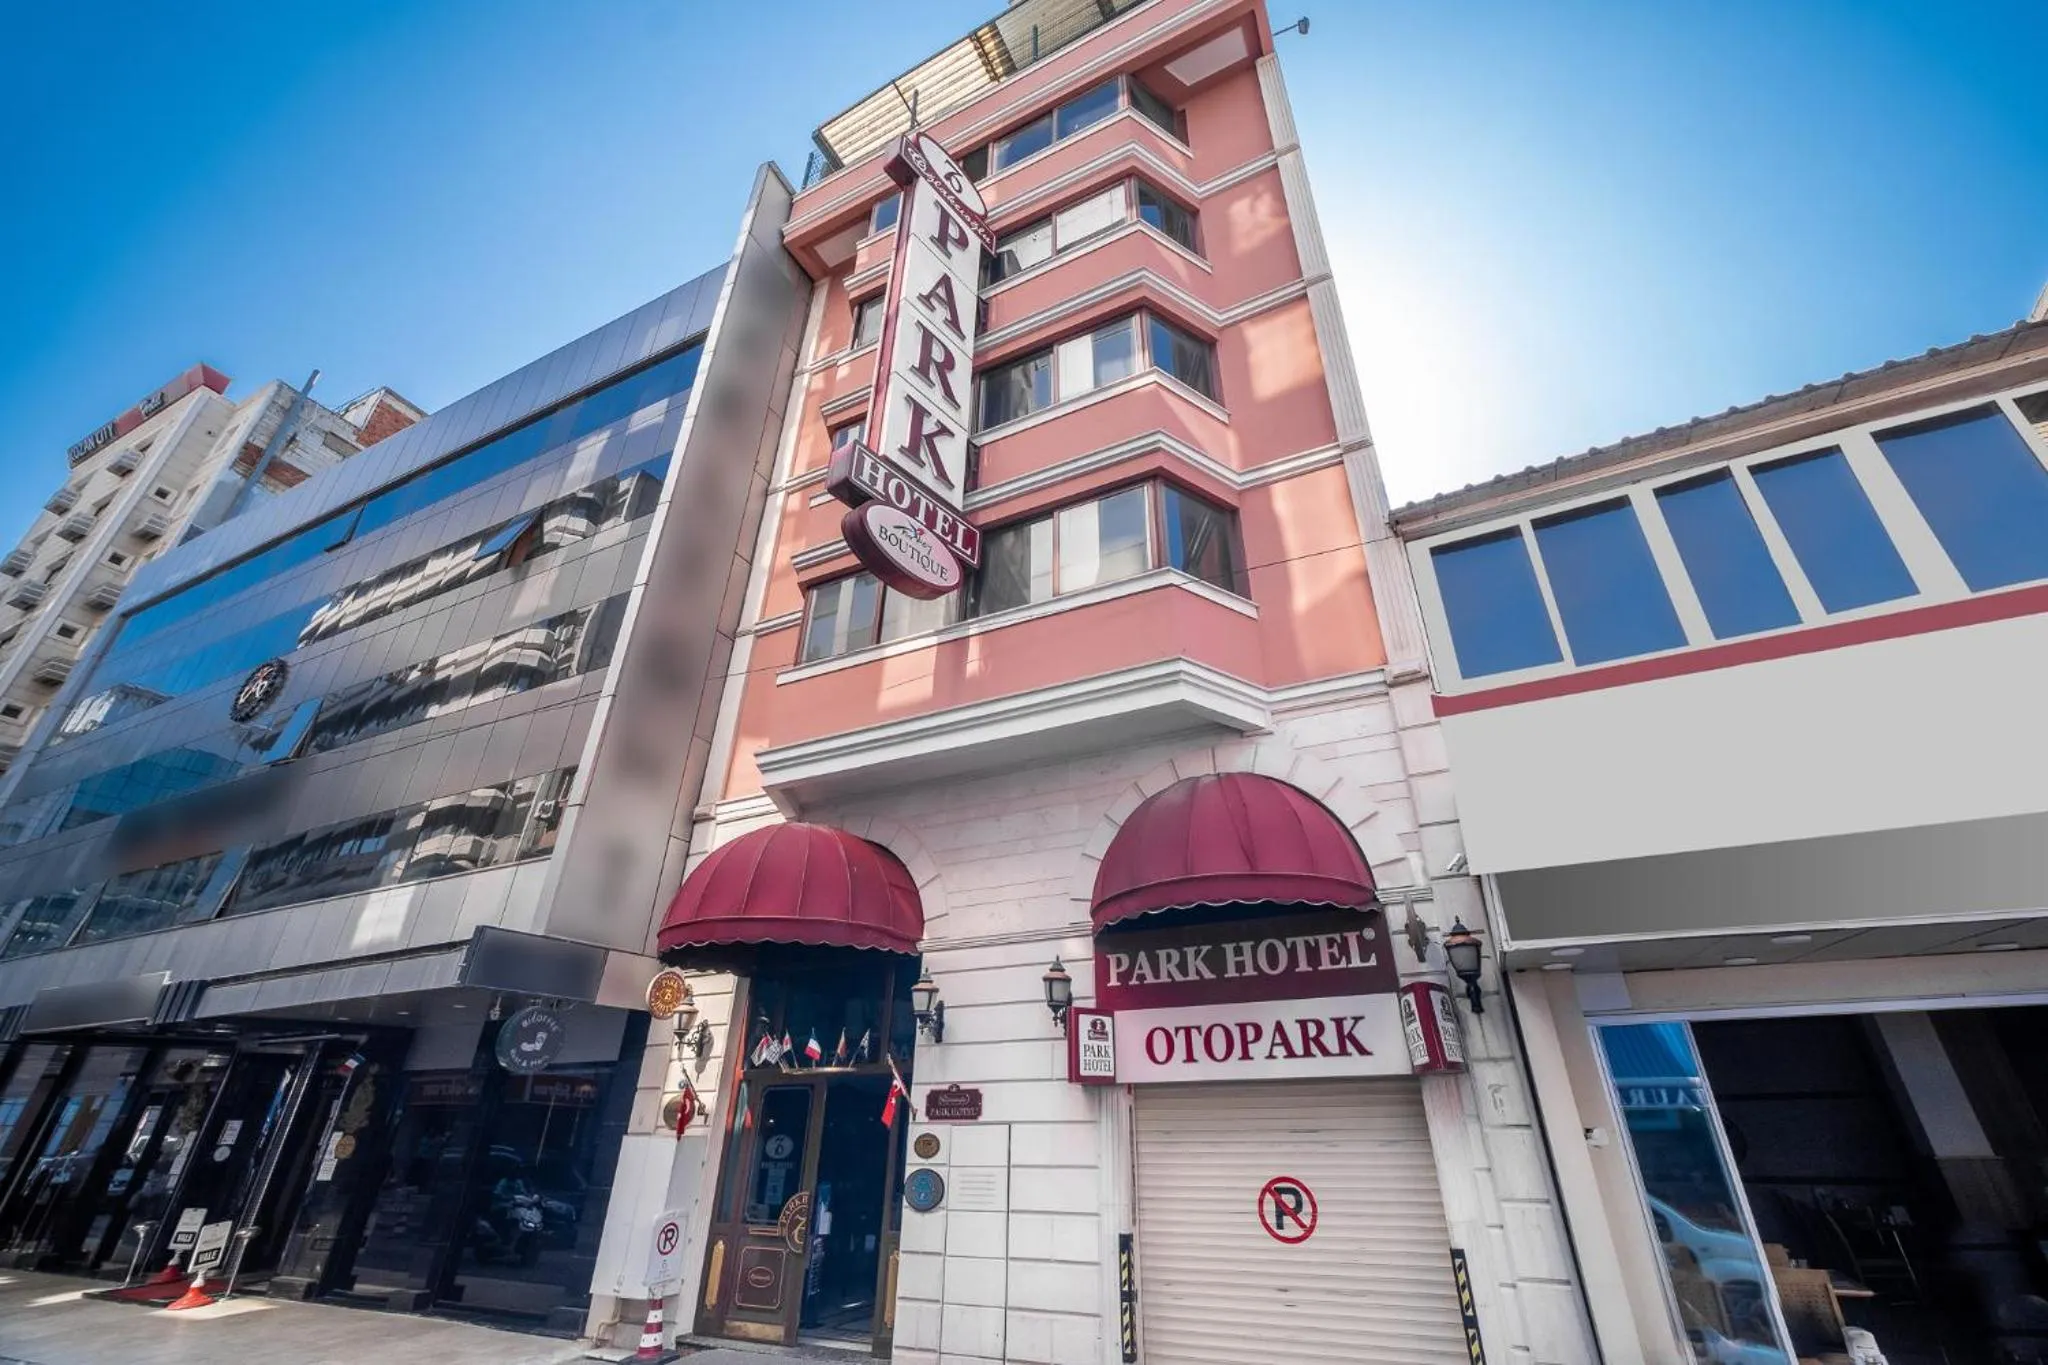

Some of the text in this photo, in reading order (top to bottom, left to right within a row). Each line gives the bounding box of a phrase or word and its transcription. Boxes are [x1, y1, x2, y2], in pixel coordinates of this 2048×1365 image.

[898, 199, 969, 489] PARK
[859, 452, 973, 556] HOTEL
[878, 524, 949, 581] BOUTIQUE
[1106, 931, 1377, 987] PARK HOTEL
[1083, 1044, 1111, 1058] PARK
[1083, 1059, 1112, 1072] HOTEL
[1144, 1015, 1374, 1066] OTOPARK
